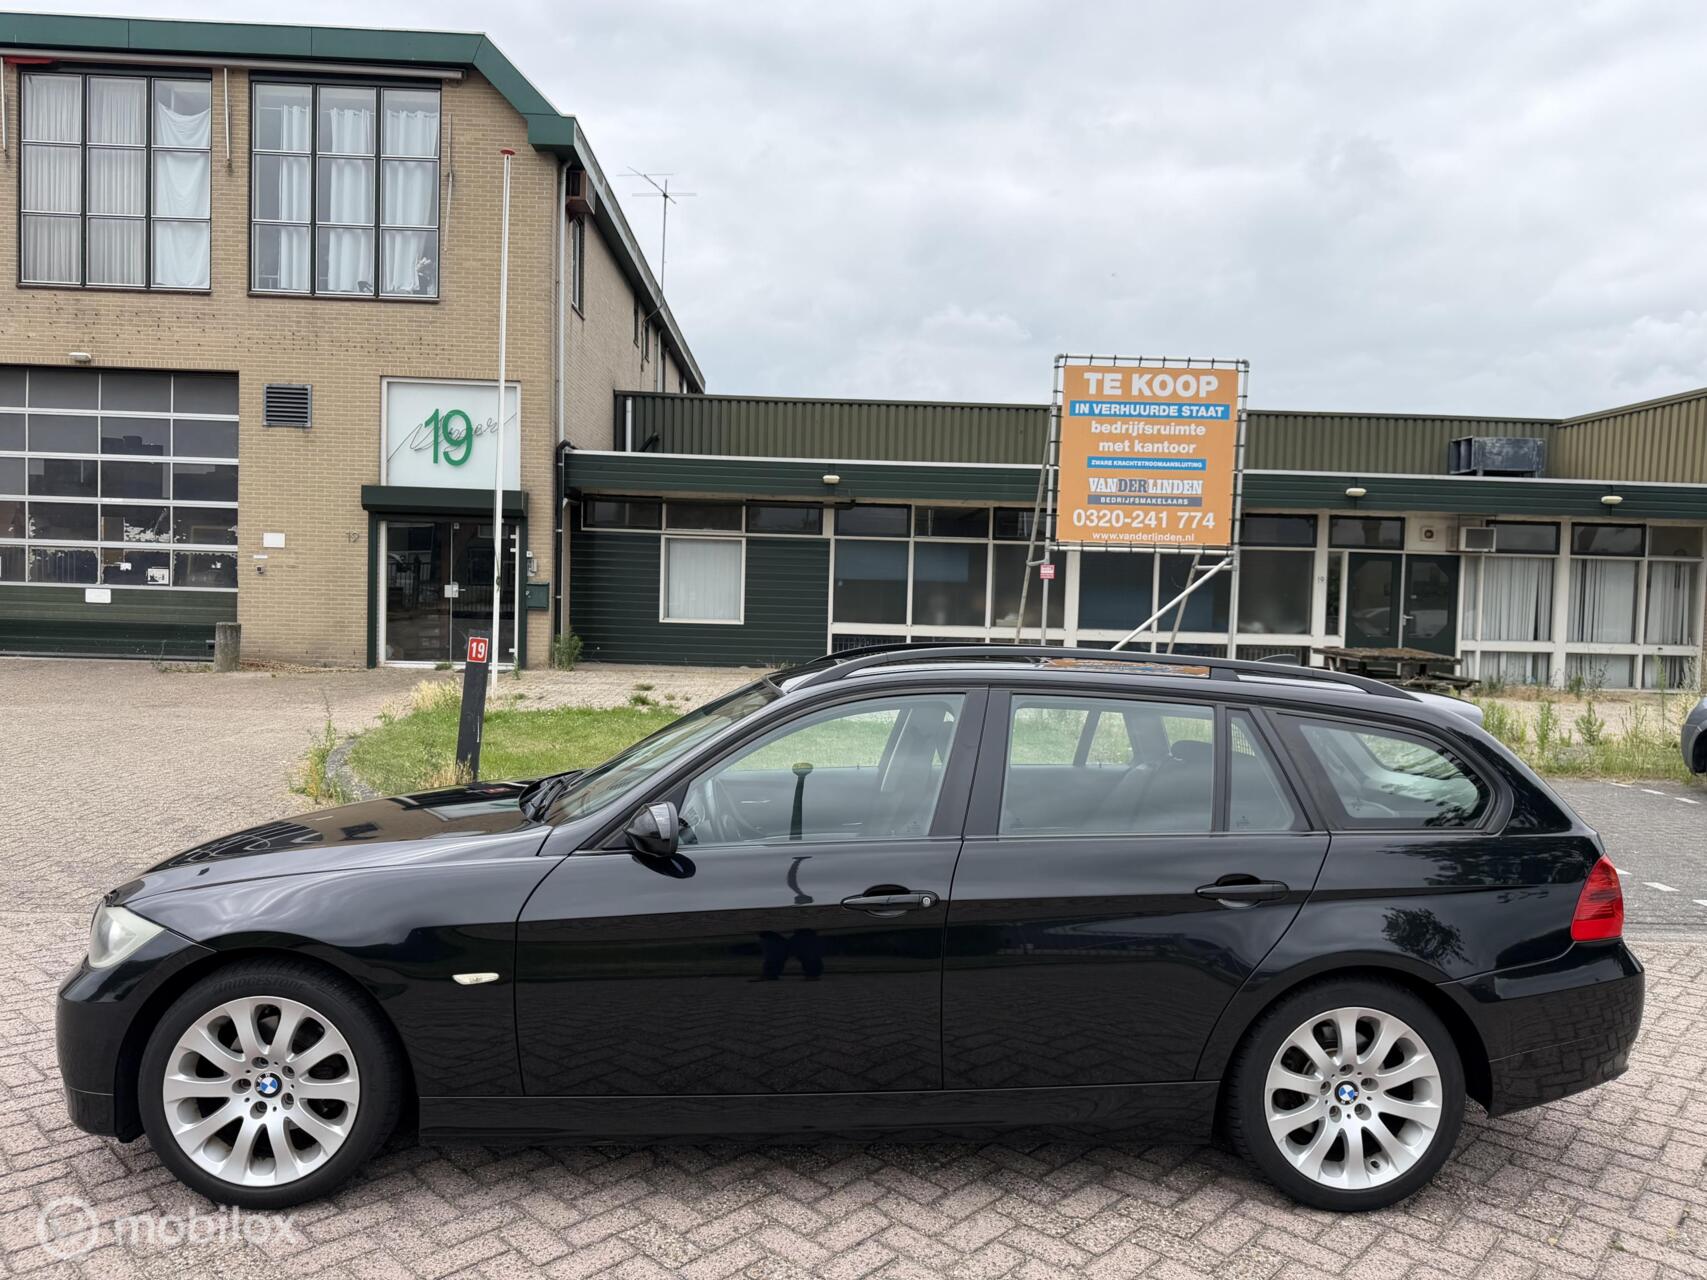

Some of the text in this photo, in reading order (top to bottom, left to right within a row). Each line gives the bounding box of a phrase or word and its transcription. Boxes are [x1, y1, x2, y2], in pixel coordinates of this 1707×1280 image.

[1083, 372, 1219, 398] TE KOOP
[1074, 403, 1225, 417] IN VERHUURDE STAAT
[1090, 420, 1207, 437] bedrijfsruimte
[423, 408, 474, 467] 19
[1098, 439, 1197, 454] met kantoor
[1100, 496, 1189, 506] BEDRIJFSMAKELAARS
[1072, 508, 1216, 530] 0320-241 774
[1091, 531, 1196, 543] www.vanderlinden.nl
[471, 642, 485, 659] 19
